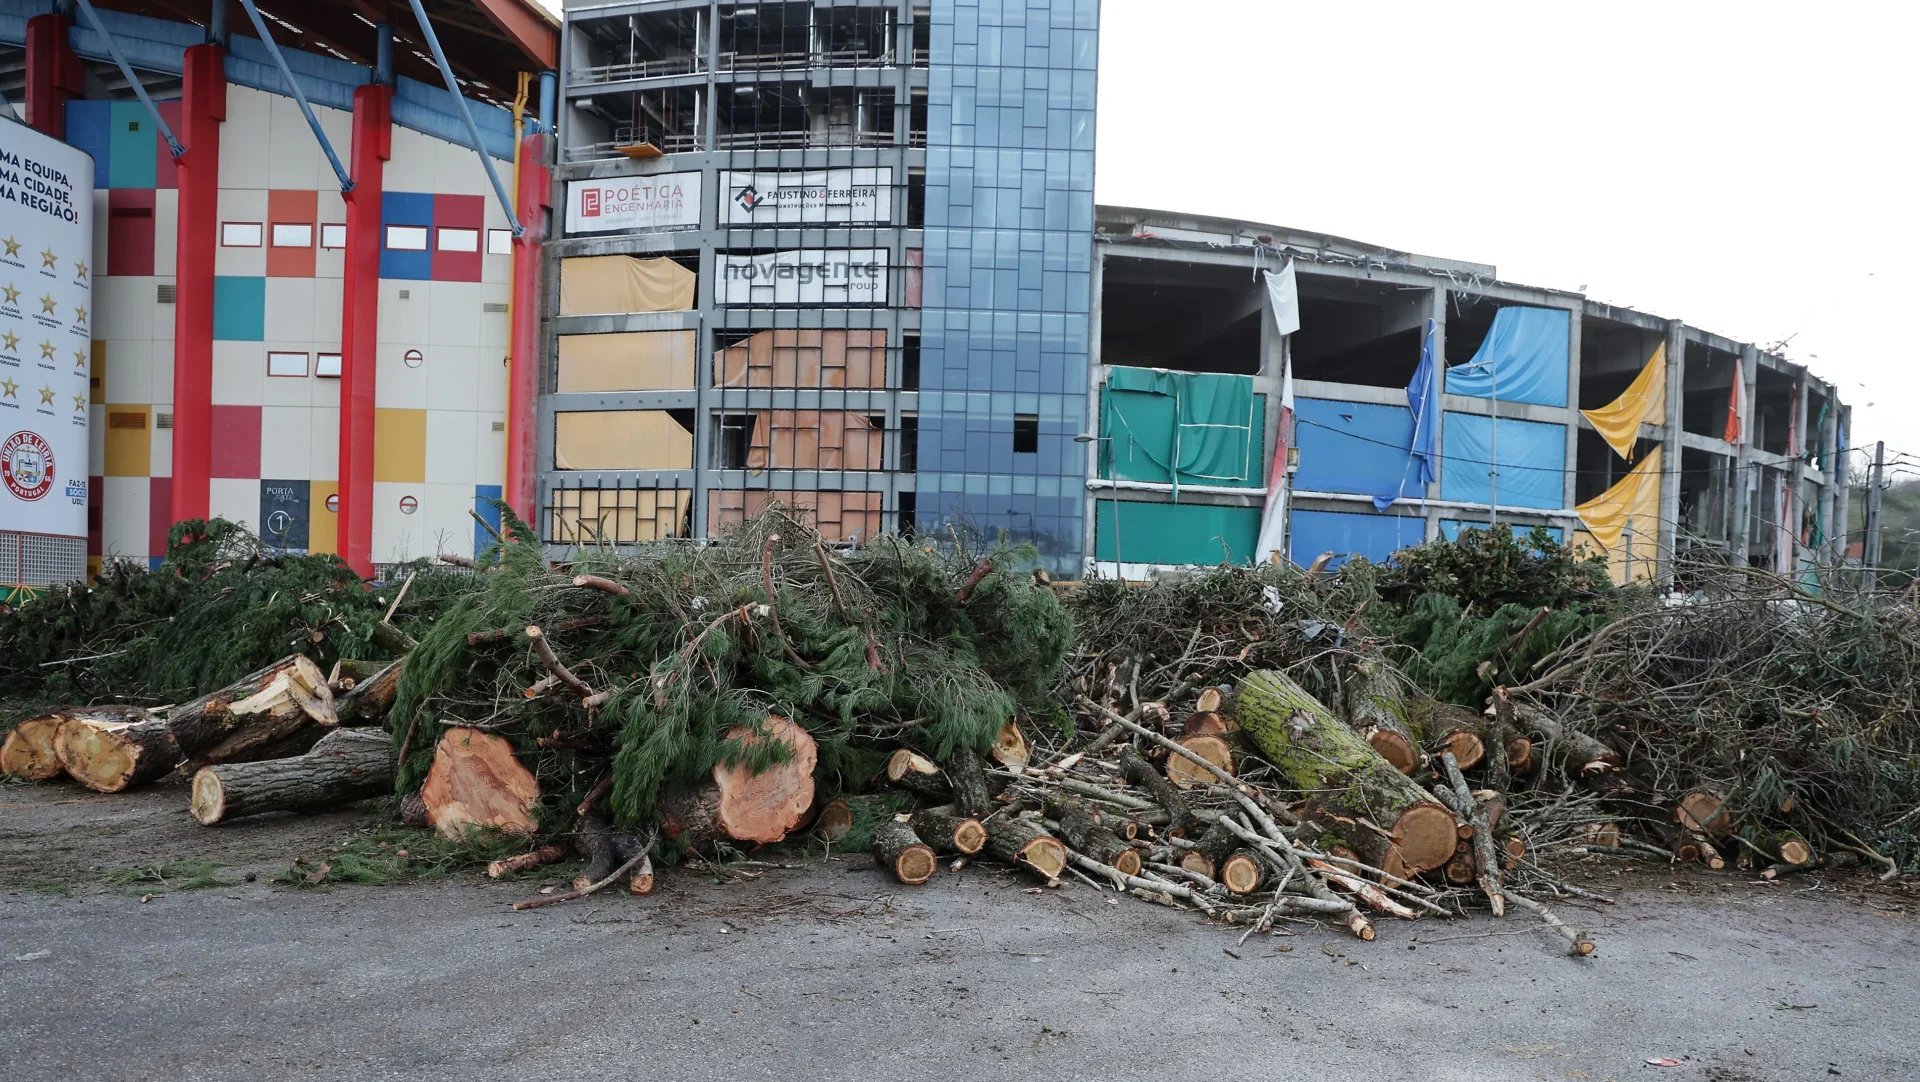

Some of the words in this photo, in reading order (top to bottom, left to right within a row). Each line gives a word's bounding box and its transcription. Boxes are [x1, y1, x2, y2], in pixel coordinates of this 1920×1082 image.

[25, 158, 73, 191] EQUIPA,
[24, 176, 72, 208] CIDADE,
[605, 185, 683, 203] POÉTICA
[767, 190, 817, 200] FAUSTINO
[828, 189, 876, 198] FERREIRA
[21, 191, 78, 224] REGIÃO!
[605, 200, 683, 214] ENGENHARIA
[23, 434, 33, 443] DE
[34, 439, 52, 467] LEIRIA
[11, 482, 45, 496] PORTUGAL
[276, 515, 282, 530] 1
